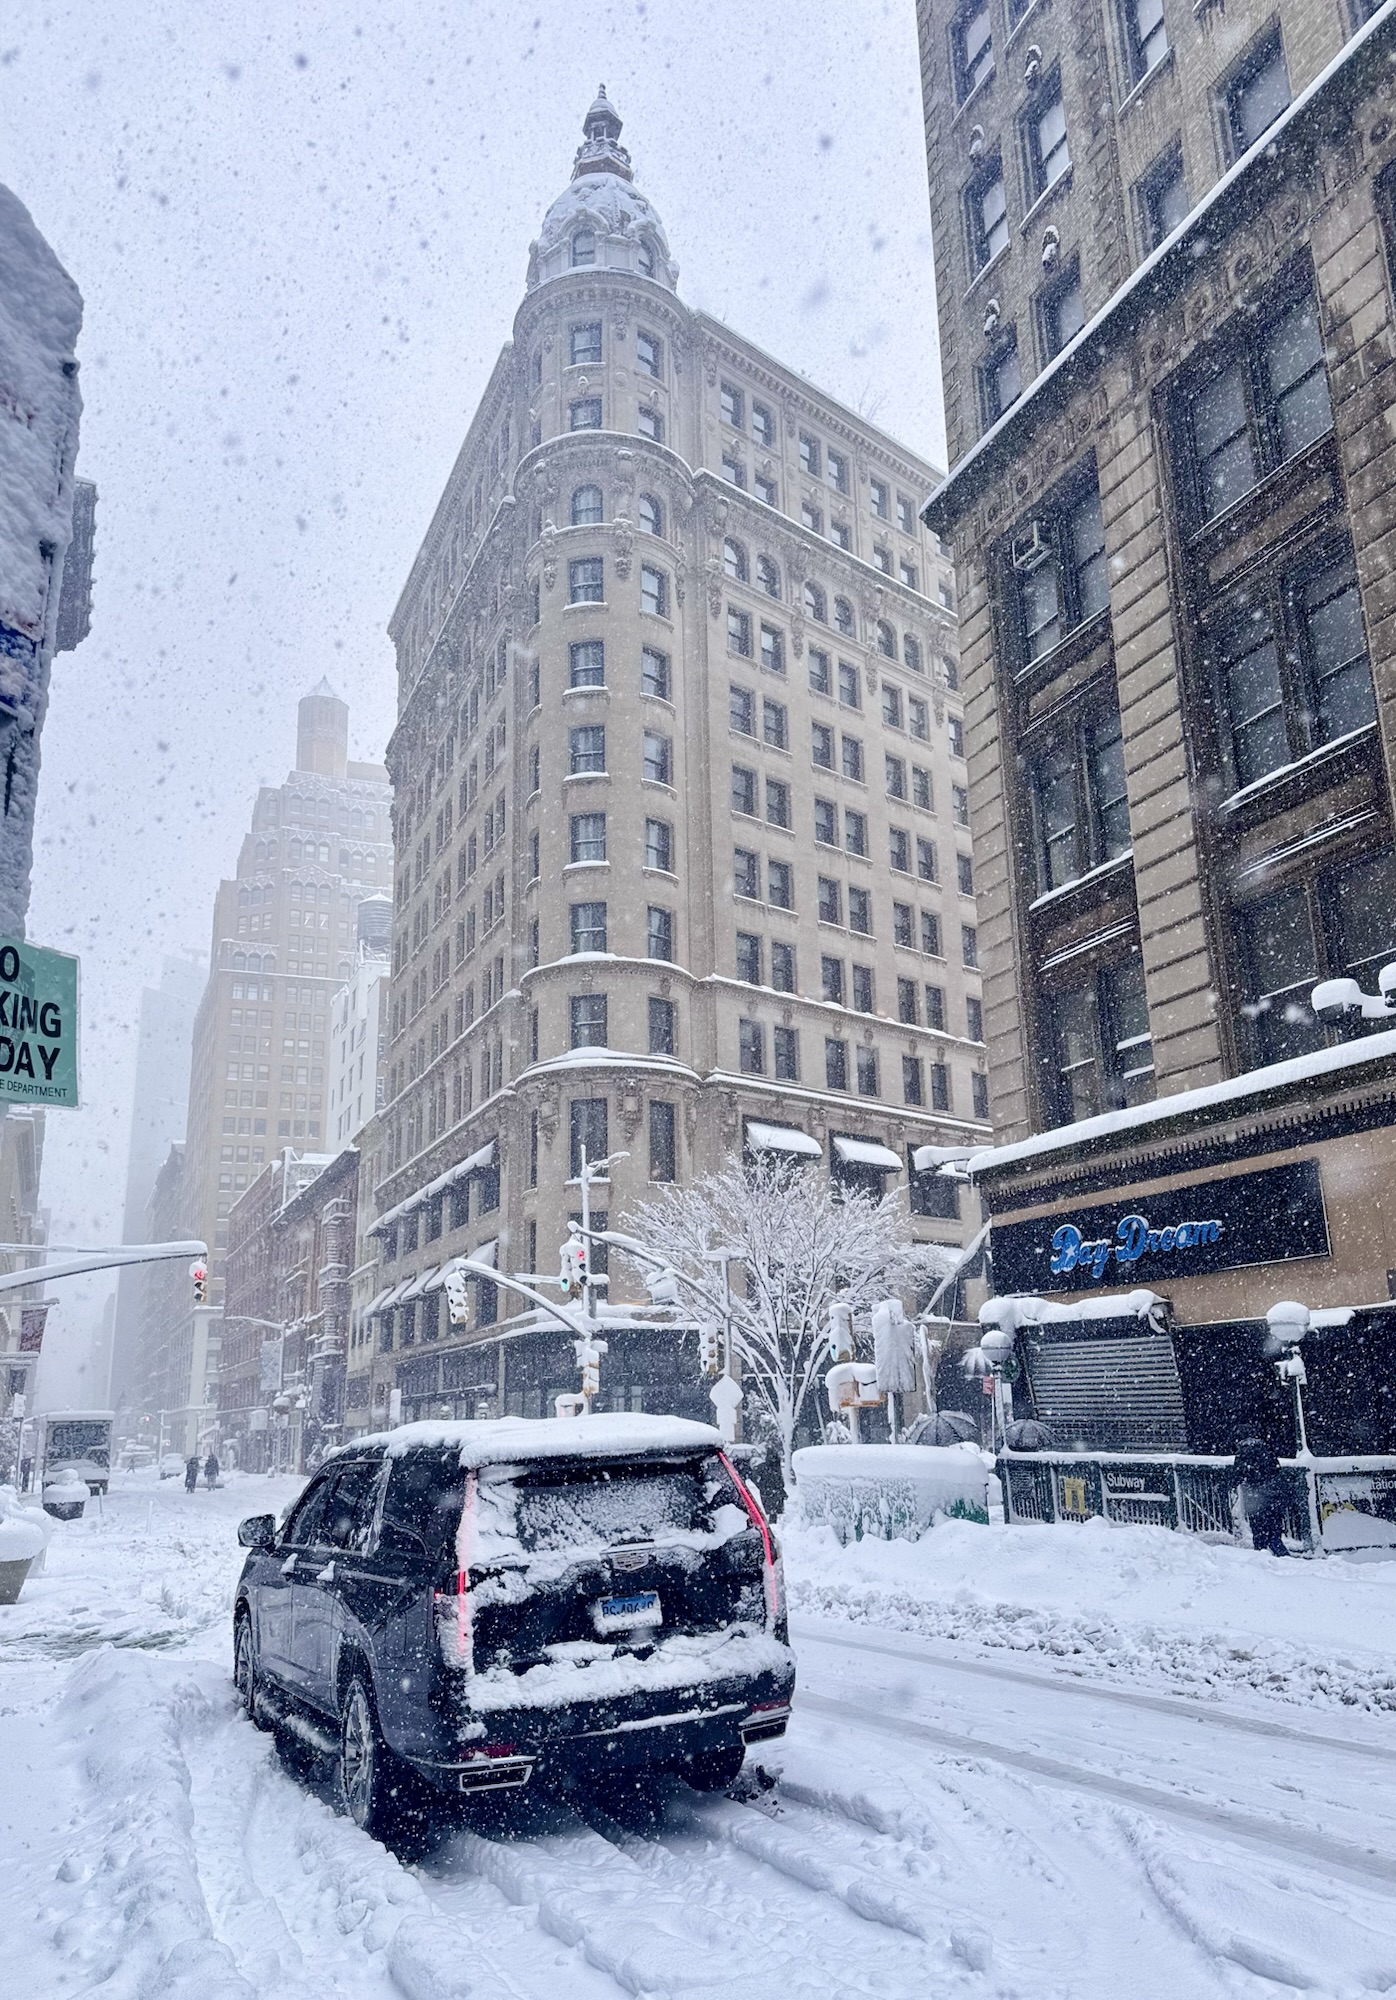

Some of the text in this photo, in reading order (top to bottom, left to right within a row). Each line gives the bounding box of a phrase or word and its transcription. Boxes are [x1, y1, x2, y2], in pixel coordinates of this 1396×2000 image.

[7, 1080, 68, 1098] DEPARTMENT
[1050, 1214, 1225, 1279] Day Dream
[1106, 1472, 1145, 1491] Subway
